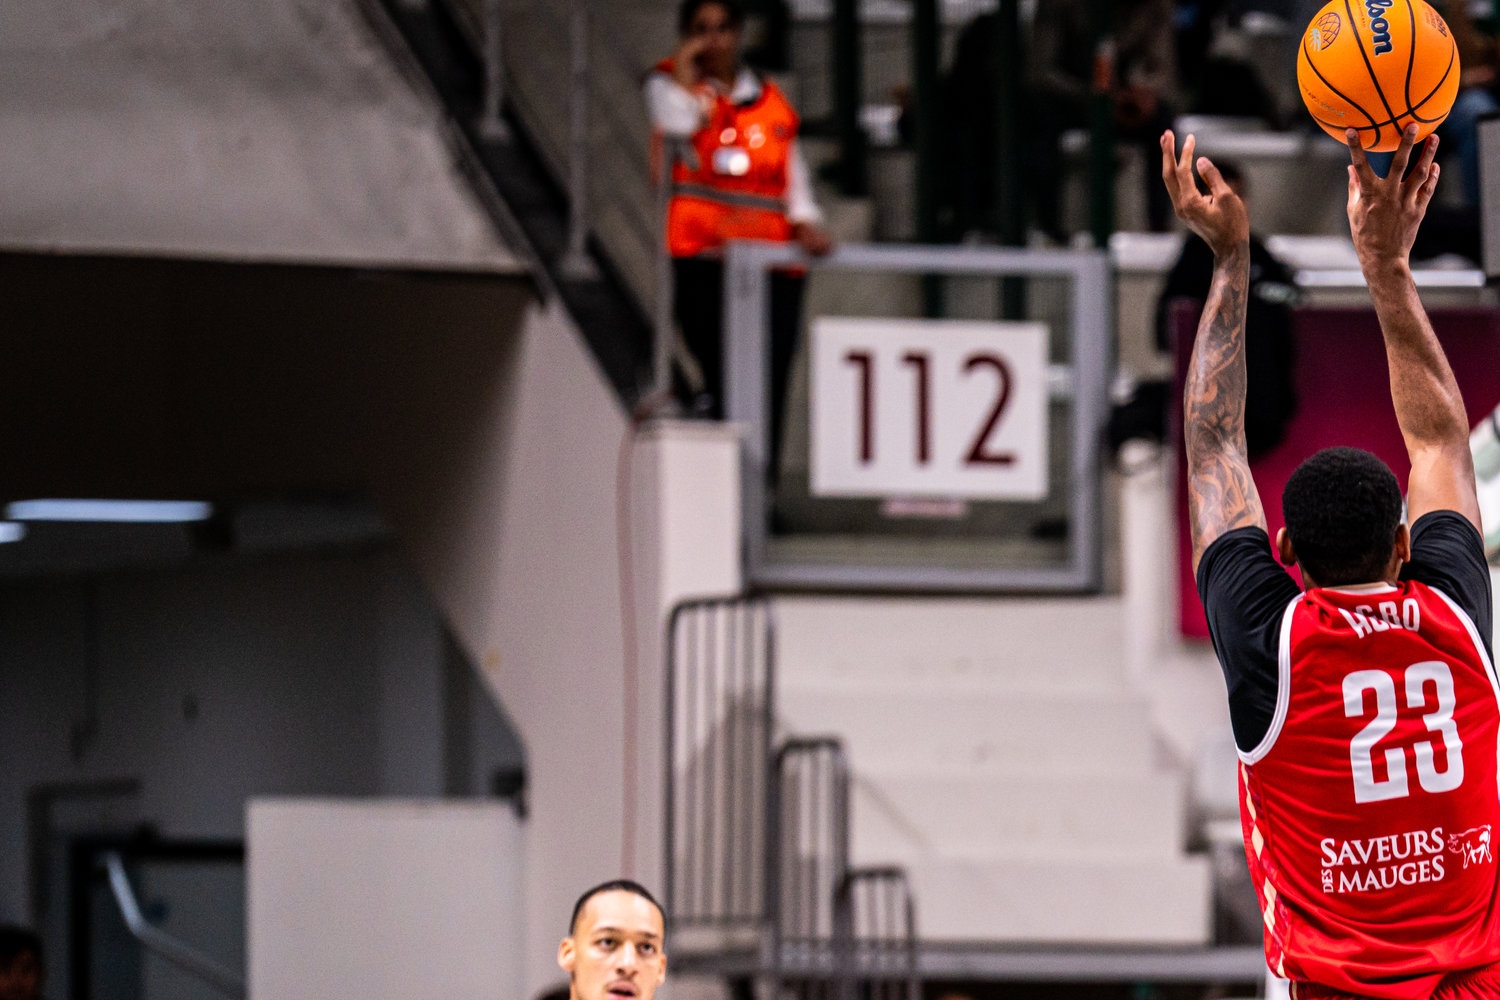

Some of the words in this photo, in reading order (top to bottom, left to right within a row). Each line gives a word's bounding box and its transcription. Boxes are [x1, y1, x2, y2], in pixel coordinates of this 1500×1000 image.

[1364, 0, 1393, 56] lson
[841, 349, 1018, 467] 112
[1342, 661, 1465, 804] 23
[1320, 827, 1445, 868] SAVEURS
[1321, 868, 1334, 893] DES
[1338, 855, 1445, 893] MAUGES
